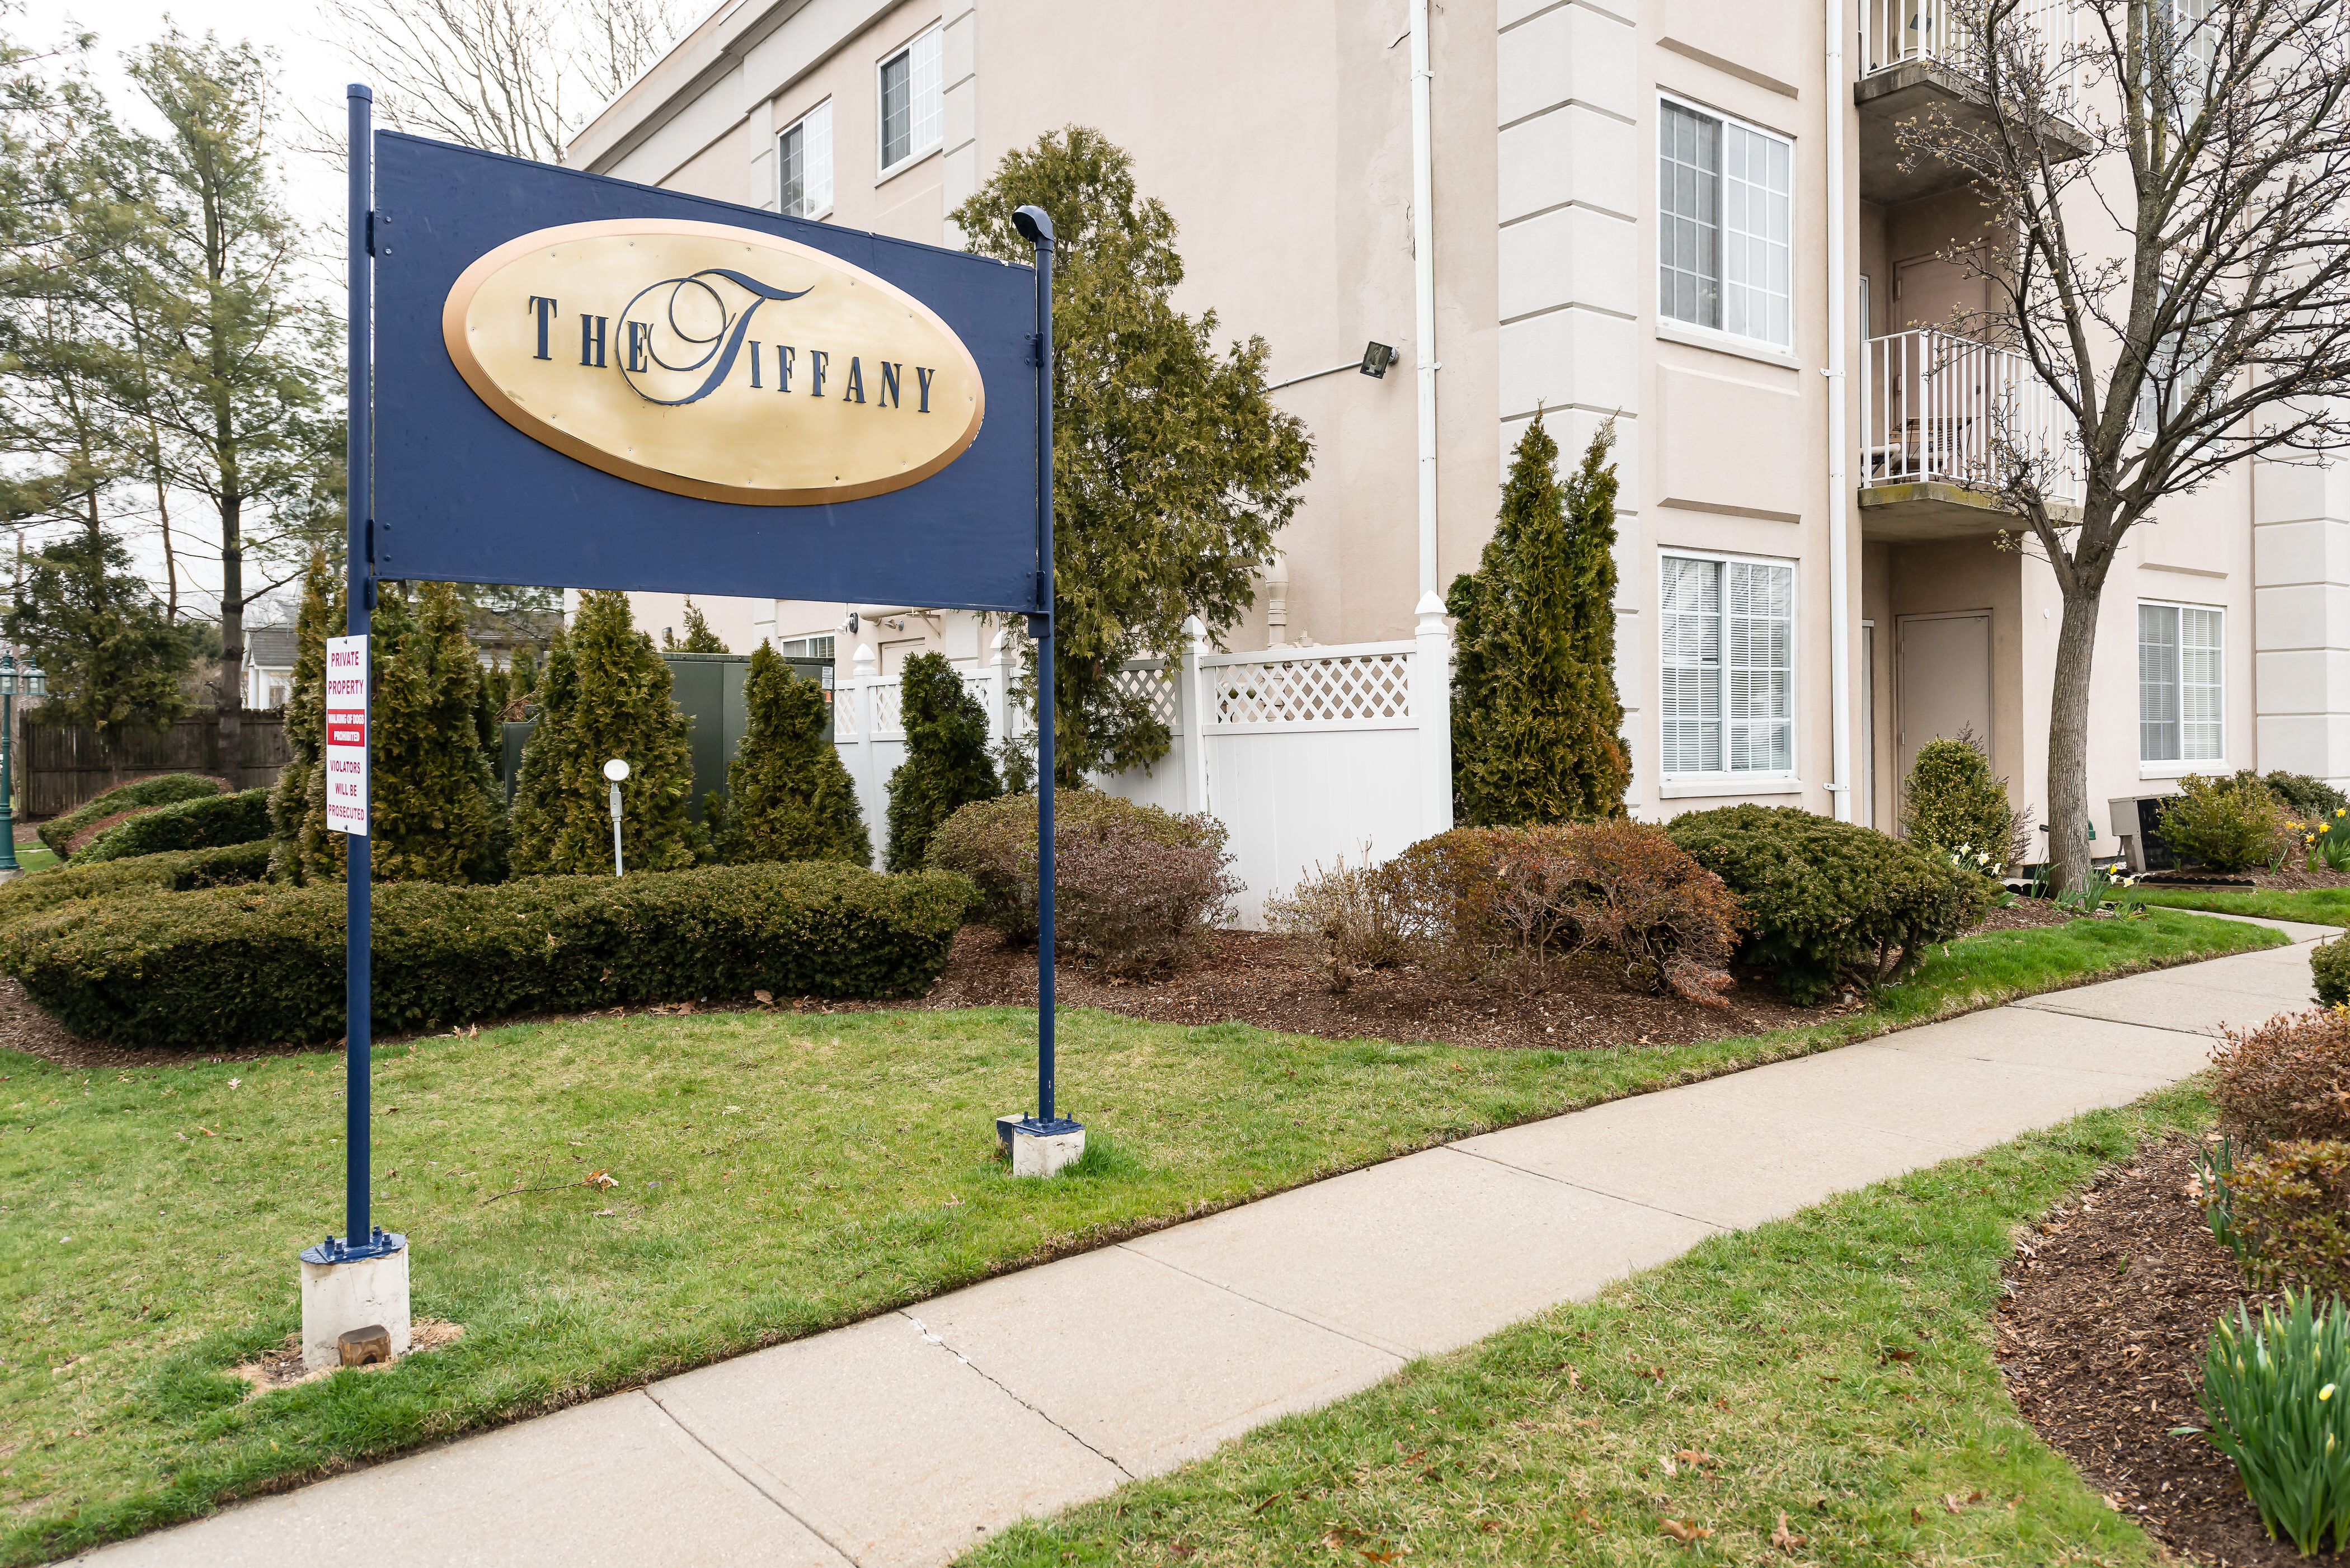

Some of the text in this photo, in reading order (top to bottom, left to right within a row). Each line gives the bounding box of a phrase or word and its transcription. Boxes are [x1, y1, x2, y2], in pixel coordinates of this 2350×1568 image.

[528, 268, 936, 413] THE TIFFANY
[331, 651, 359, 667] PRIVATE
[328, 680, 364, 694] PROPERTY
[328, 714, 364, 724] WALKING OF DOGS
[333, 731, 360, 742] PROHIBITED
[330, 760, 360, 774] VIOLATORS
[335, 784, 357, 797] WILL BE
[328, 804, 364, 820] PROSECUTED
